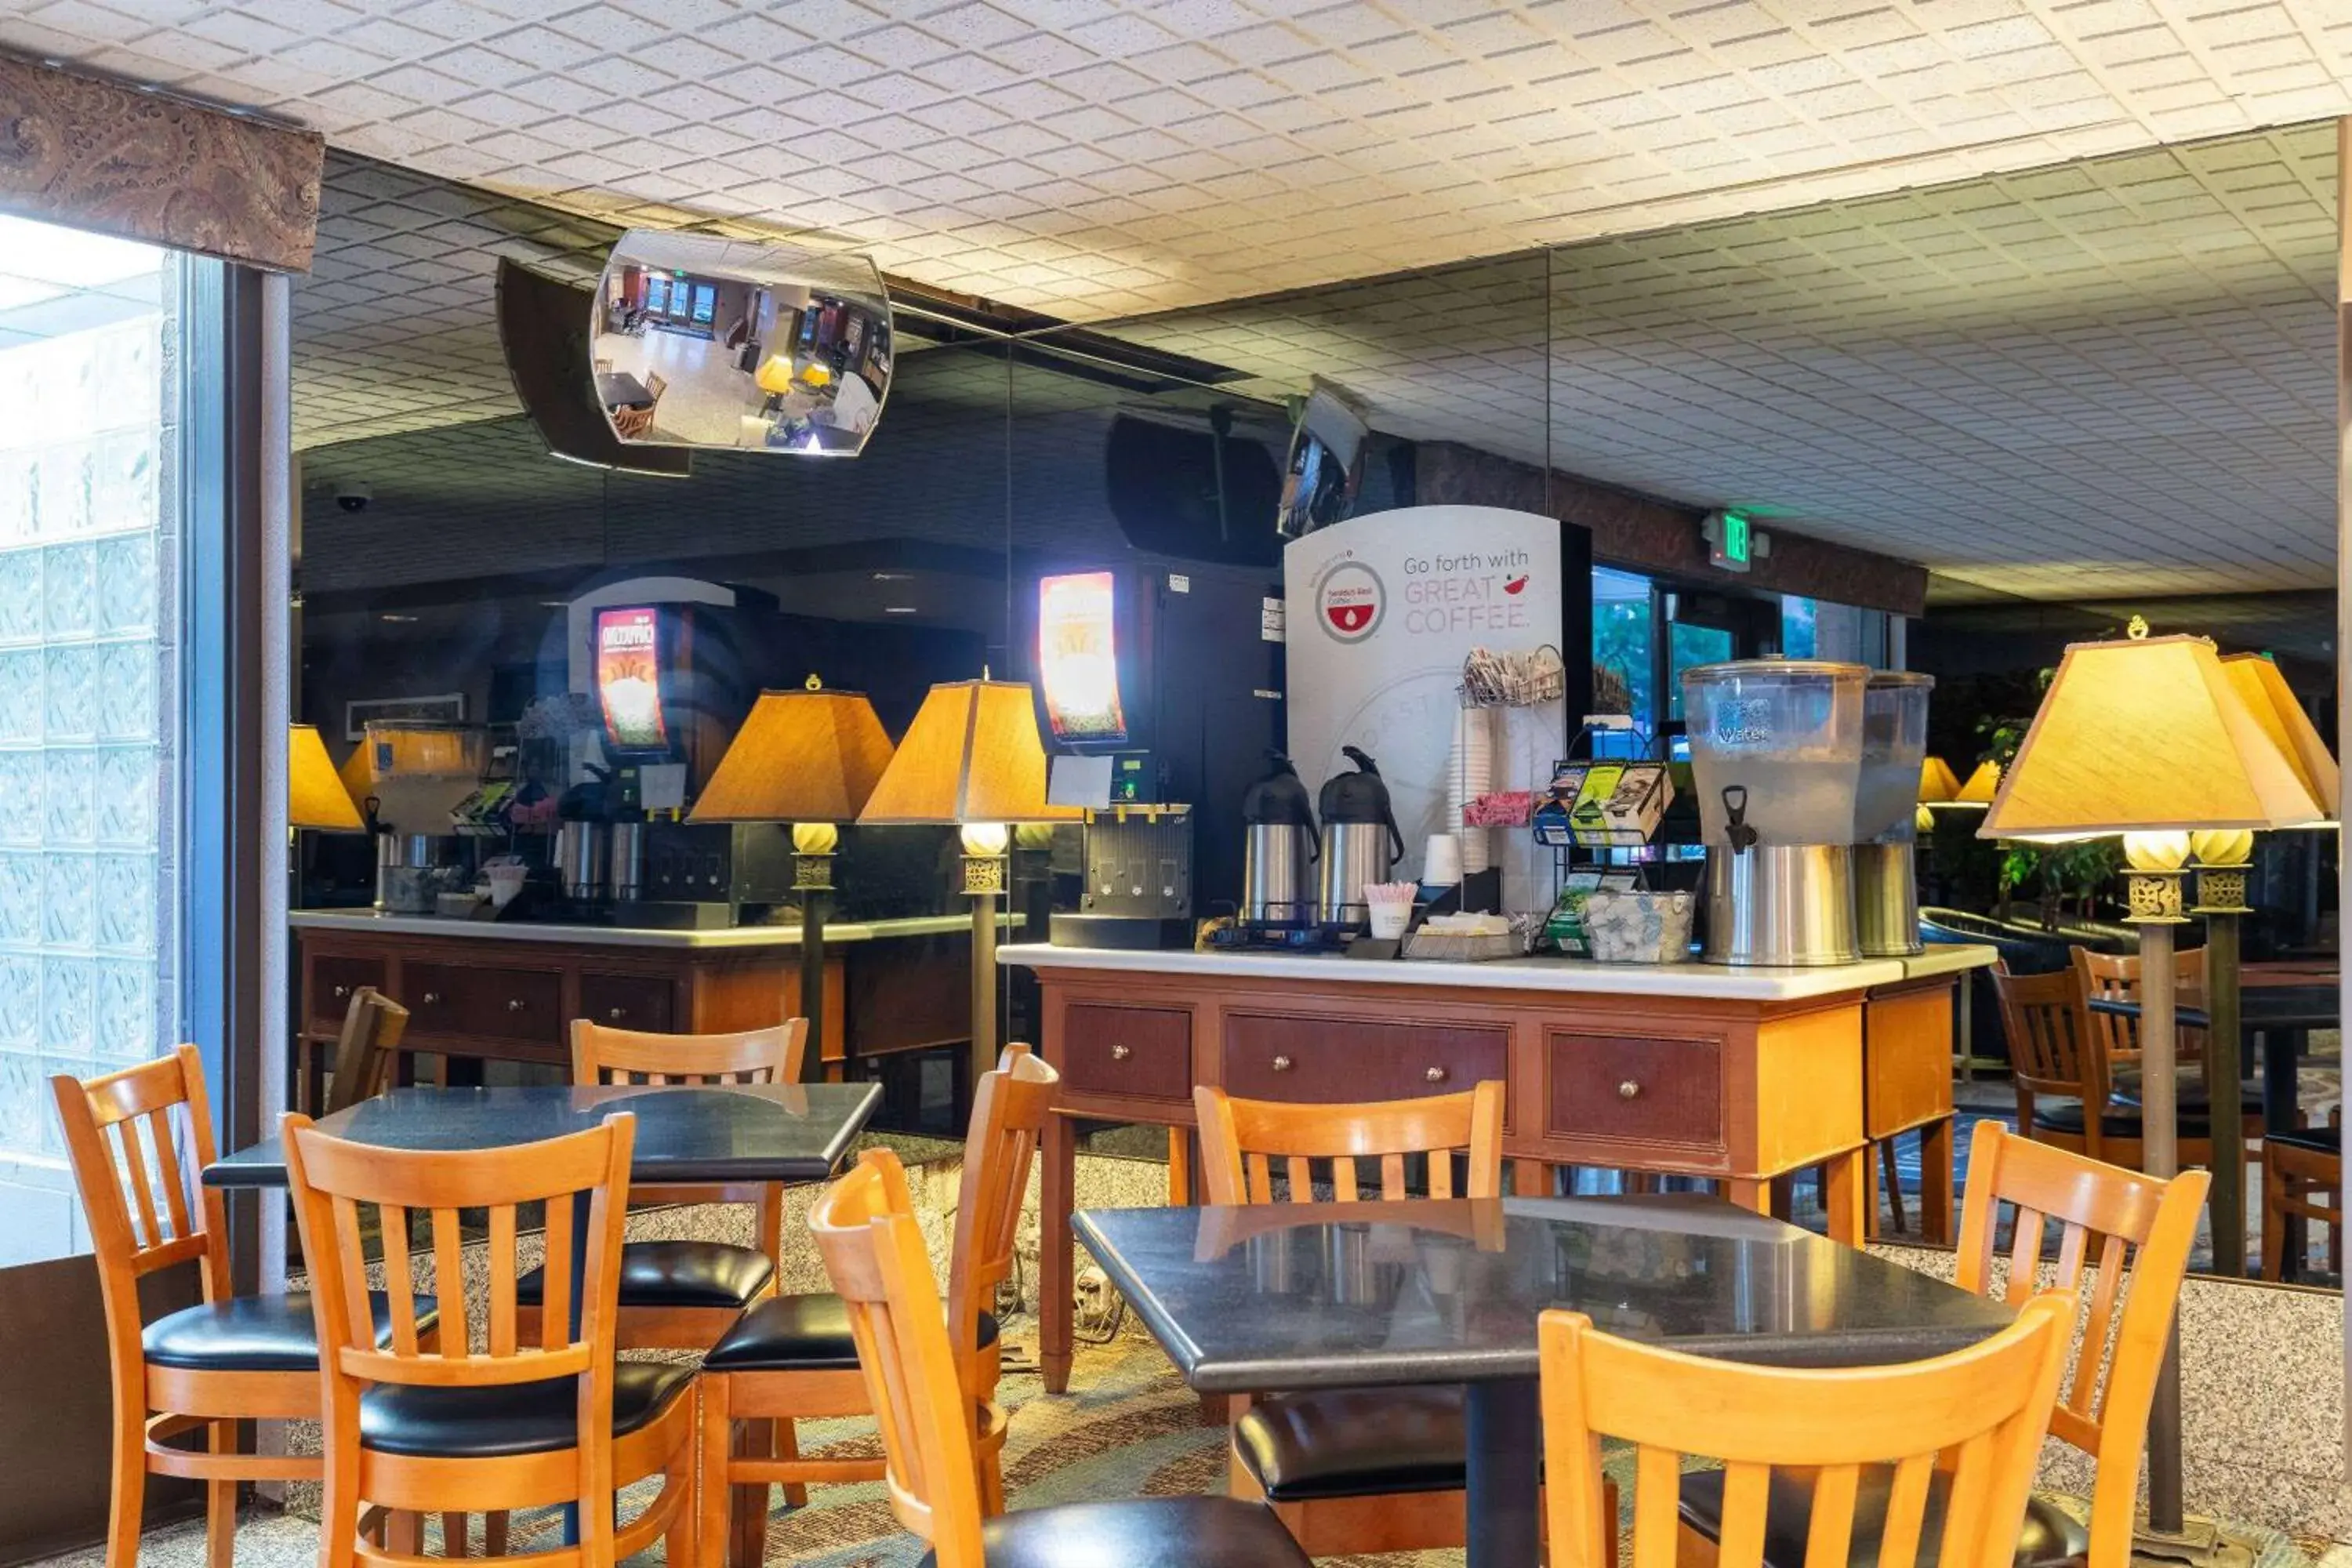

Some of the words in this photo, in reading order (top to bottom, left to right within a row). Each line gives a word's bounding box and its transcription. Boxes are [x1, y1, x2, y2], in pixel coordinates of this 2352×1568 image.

[1404, 557, 1428, 575] Go
[1436, 553, 1481, 572] forth
[1487, 549, 1529, 568] with
[1405, 575, 1496, 604] GREAT
[1719, 728, 1767, 744] Water
